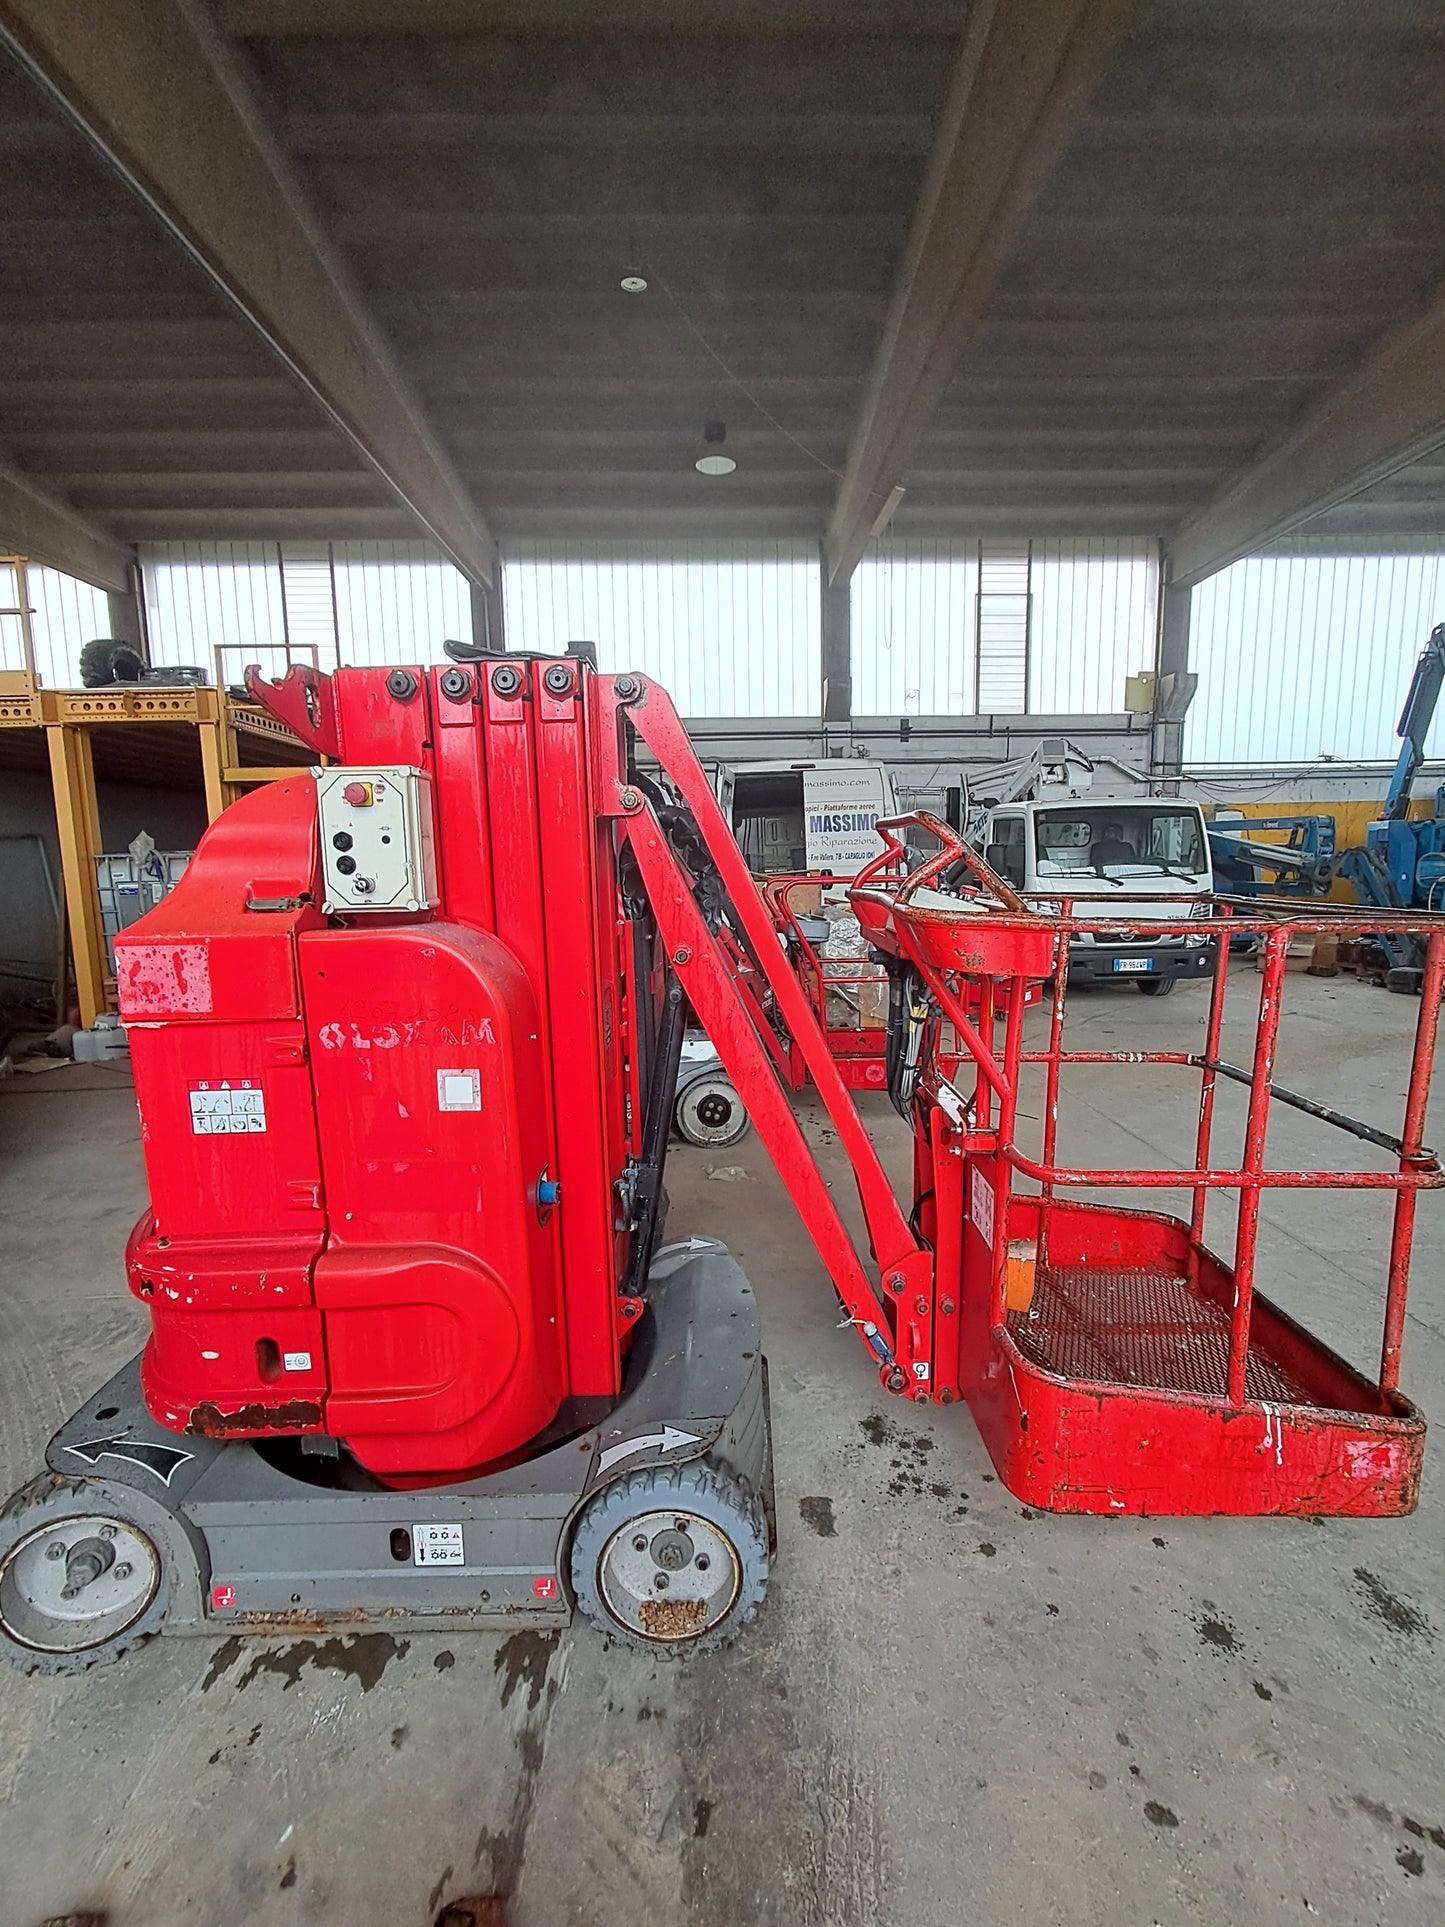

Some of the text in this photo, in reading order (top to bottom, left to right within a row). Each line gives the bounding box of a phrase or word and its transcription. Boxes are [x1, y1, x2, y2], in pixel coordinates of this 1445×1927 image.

[824, 803, 858, 812] Piattaforme
[810, 812, 879, 833] MASSIMO
[821, 835, 877, 848] Riparazione
